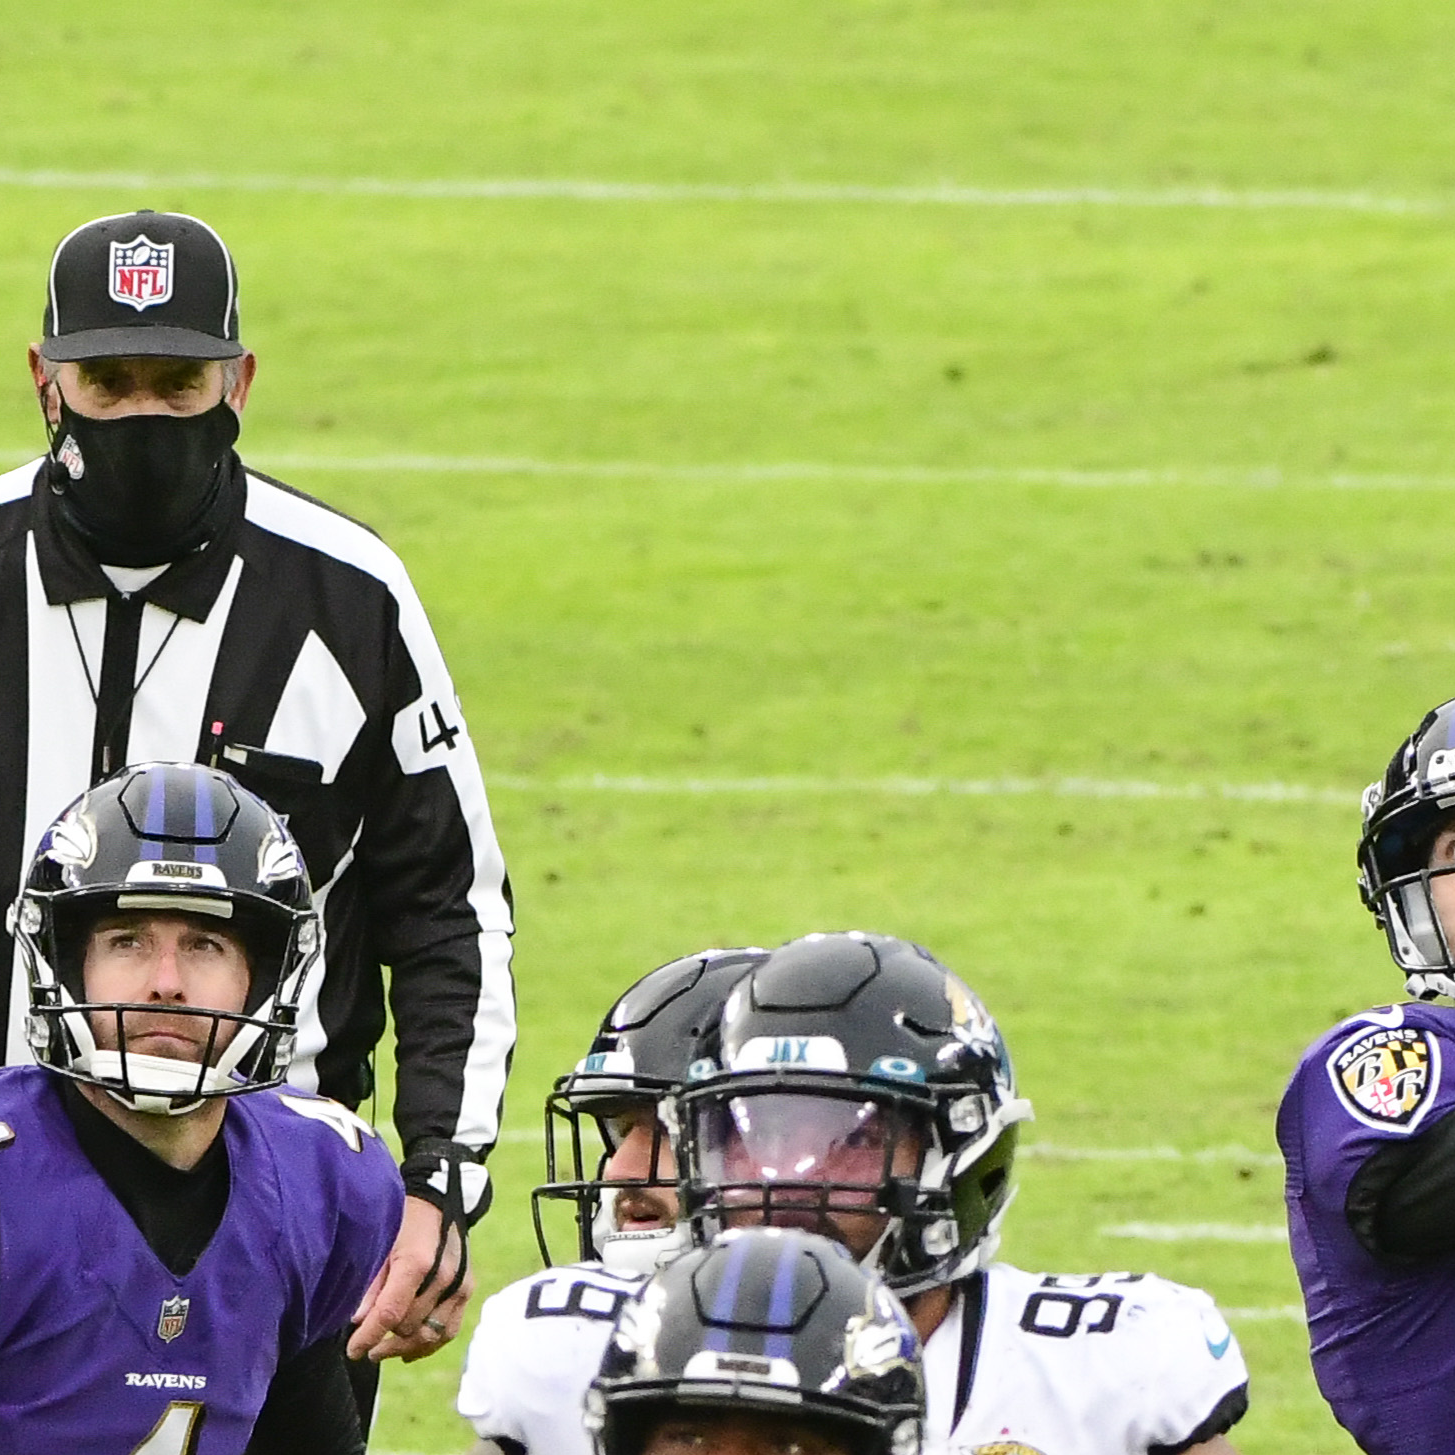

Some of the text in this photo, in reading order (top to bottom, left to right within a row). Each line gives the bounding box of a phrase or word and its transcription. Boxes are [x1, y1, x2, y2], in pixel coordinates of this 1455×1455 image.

[117, 268, 164, 299] NFL
[418, 701, 460, 753] 4
[152, 863, 203, 879] RAVENS
[766, 1038, 809, 1063] JAX
[1337, 1029, 1418, 1069] RAVENS
[125, 1372, 207, 1390] RAVENS
